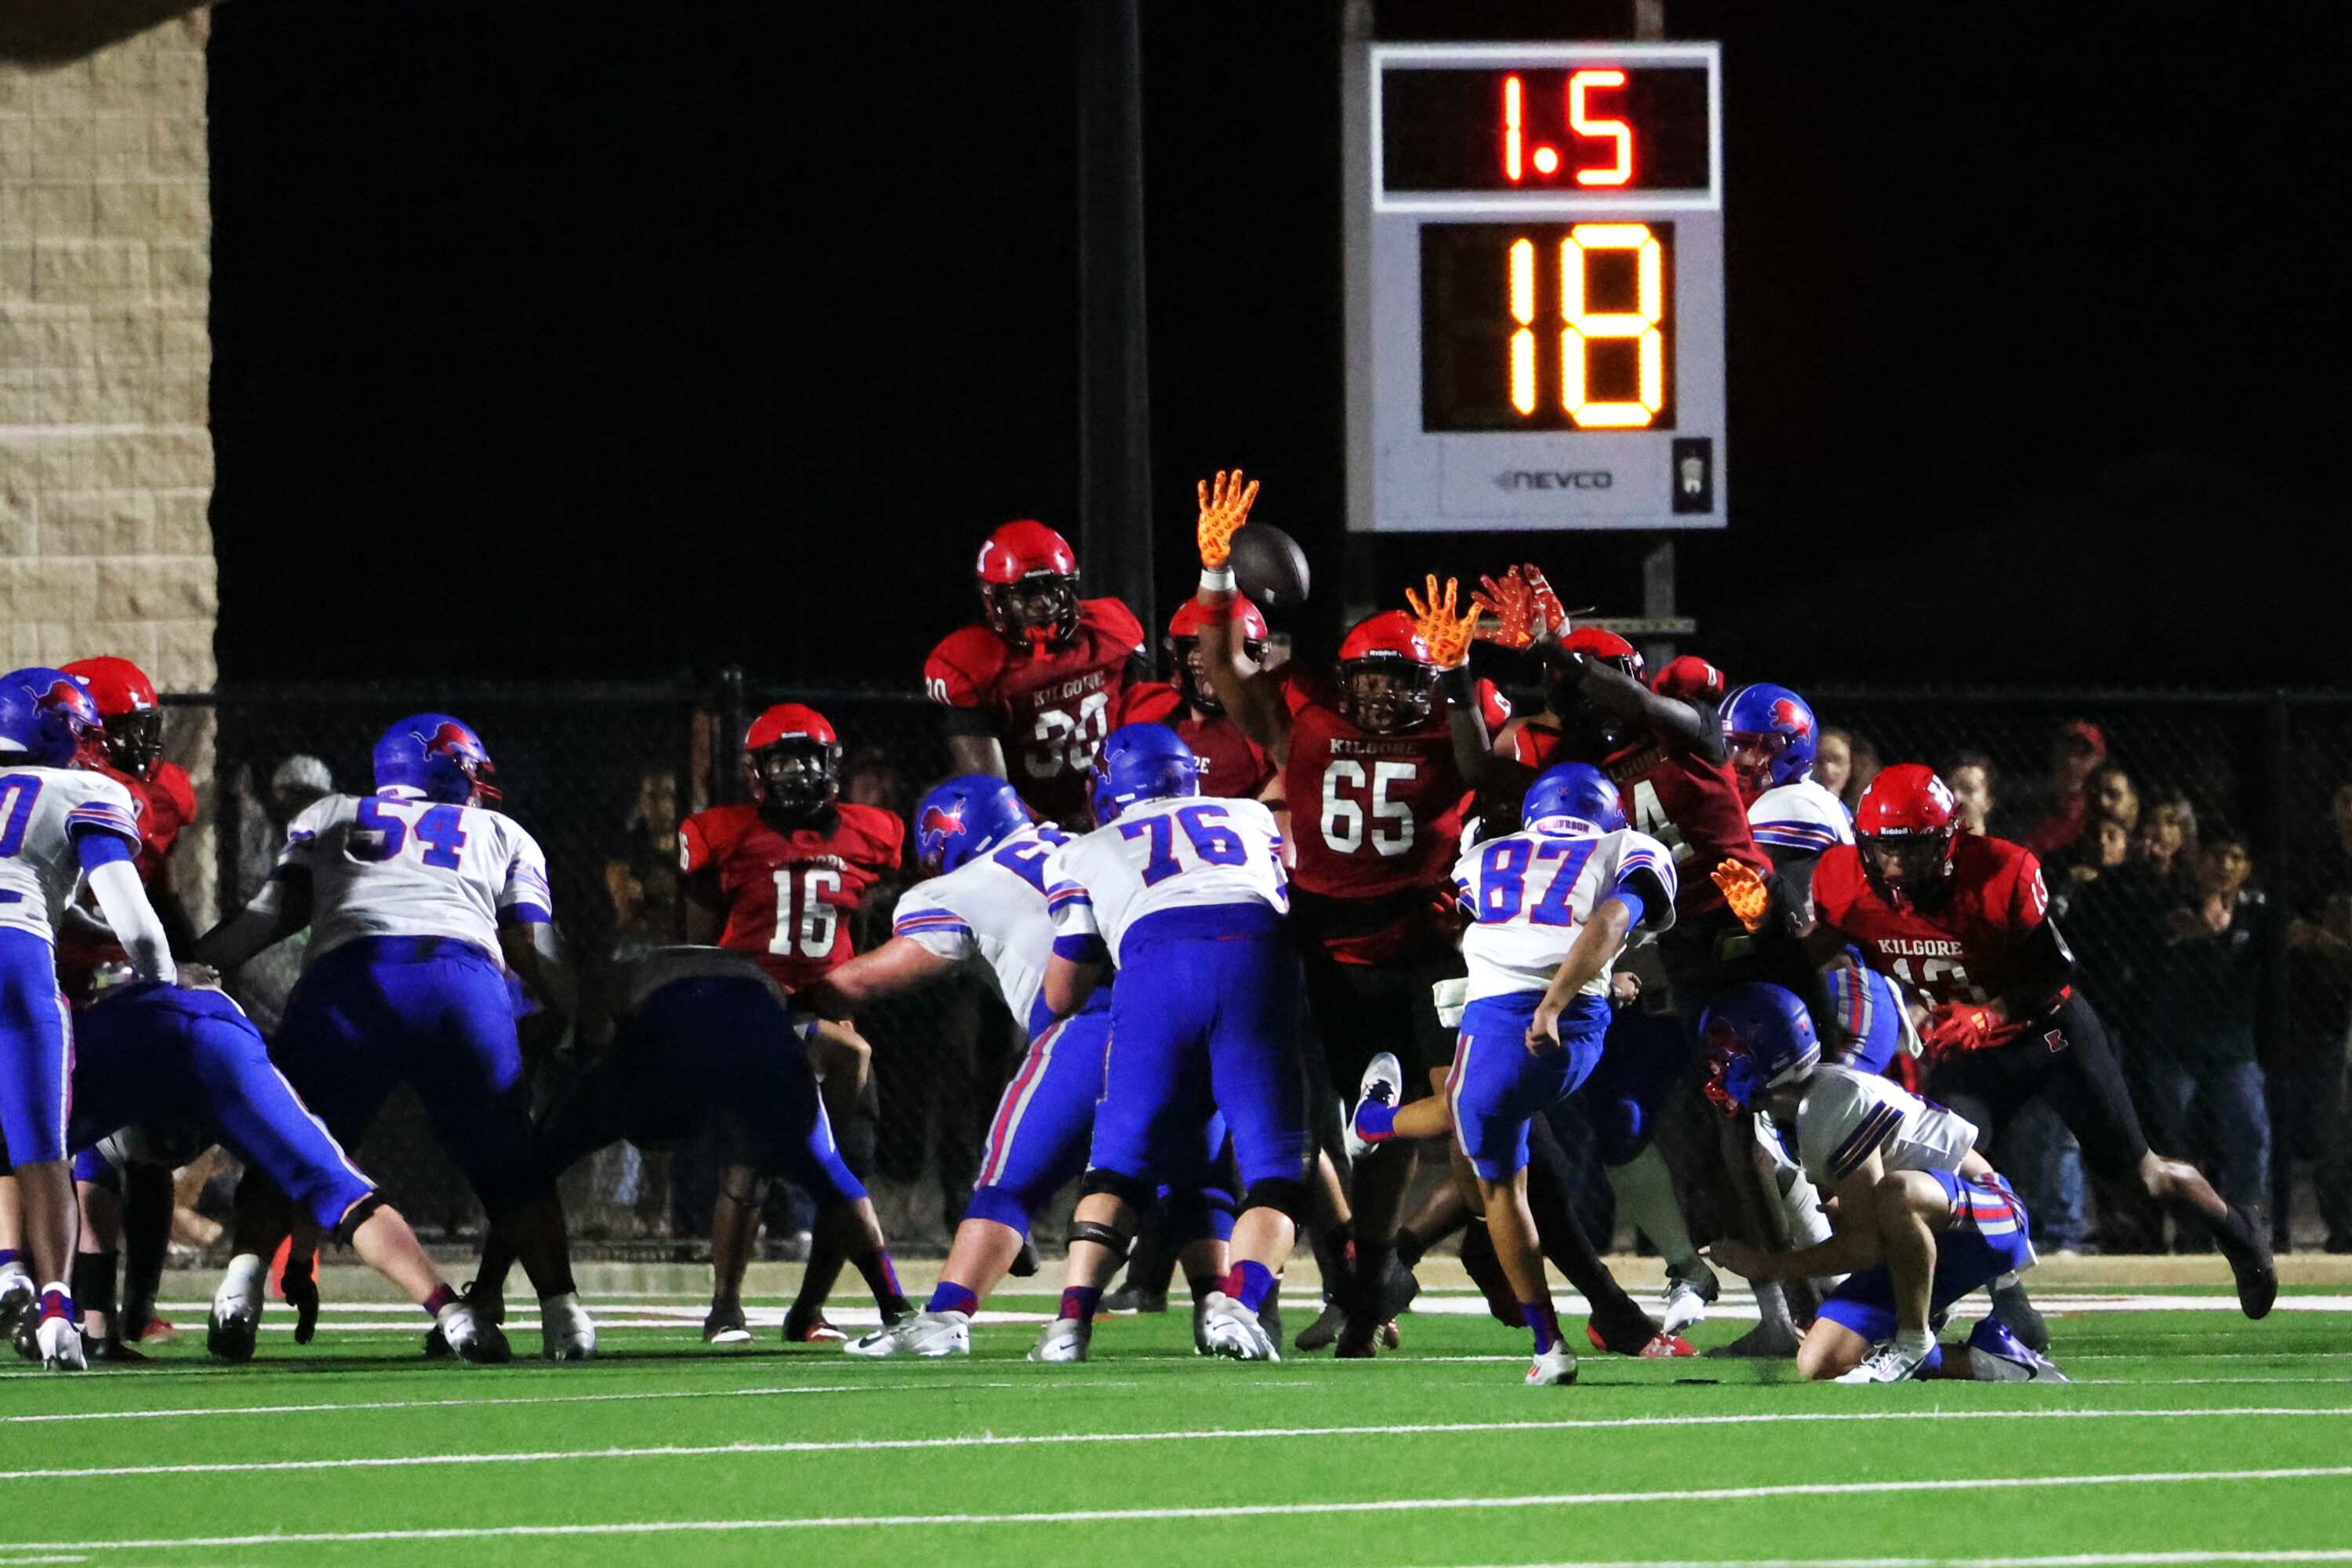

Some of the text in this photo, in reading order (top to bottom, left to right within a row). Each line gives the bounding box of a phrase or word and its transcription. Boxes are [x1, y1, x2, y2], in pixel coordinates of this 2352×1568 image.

[1504, 69, 1632, 185] 1.5
[1509, 223, 1663, 428] 18
[1514, 472, 1612, 489] NEVCO
[1025, 691, 1109, 778] 30
[1330, 739, 1417, 754] KILGORE
[343, 796, 466, 872] 54
[1119, 804, 1248, 887] 76
[1321, 760, 1414, 856] 65
[768, 869, 841, 958] 16
[1477, 838, 1599, 927] 87
[1878, 939, 1963, 956] KILGORE
